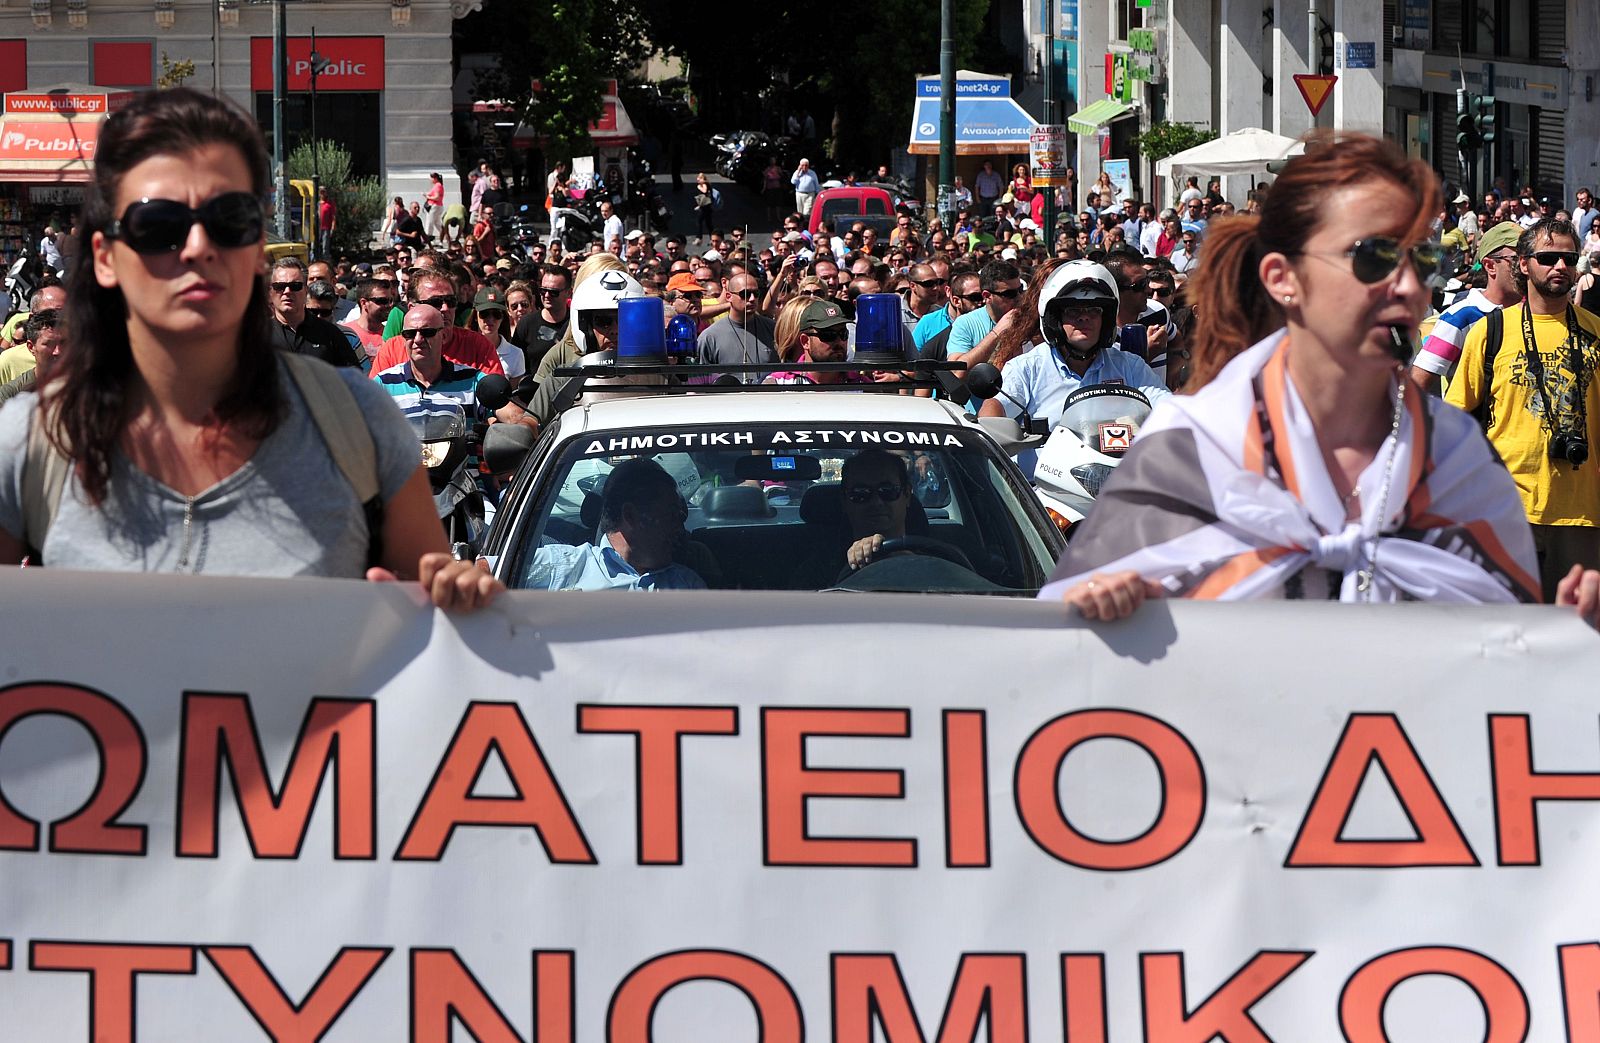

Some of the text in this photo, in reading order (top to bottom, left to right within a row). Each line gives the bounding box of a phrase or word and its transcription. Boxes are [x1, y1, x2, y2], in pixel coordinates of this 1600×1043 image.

[295, 59, 366, 76] Pblic
[11, 97, 101, 111] www.public.gr
[24, 138, 94, 151] Public
[584, 430, 964, 455] ΔΗΜΟΤΙΚΗ ΑΣΤΥΝΟΜΙΑ
[1039, 463, 1063, 478] POLICE
[0, 681, 1600, 872] ΩΜΑΤΕΙΟ ΔΗ
[0, 939, 1600, 1043] ΤΥΝΟΜΙΚΟ
